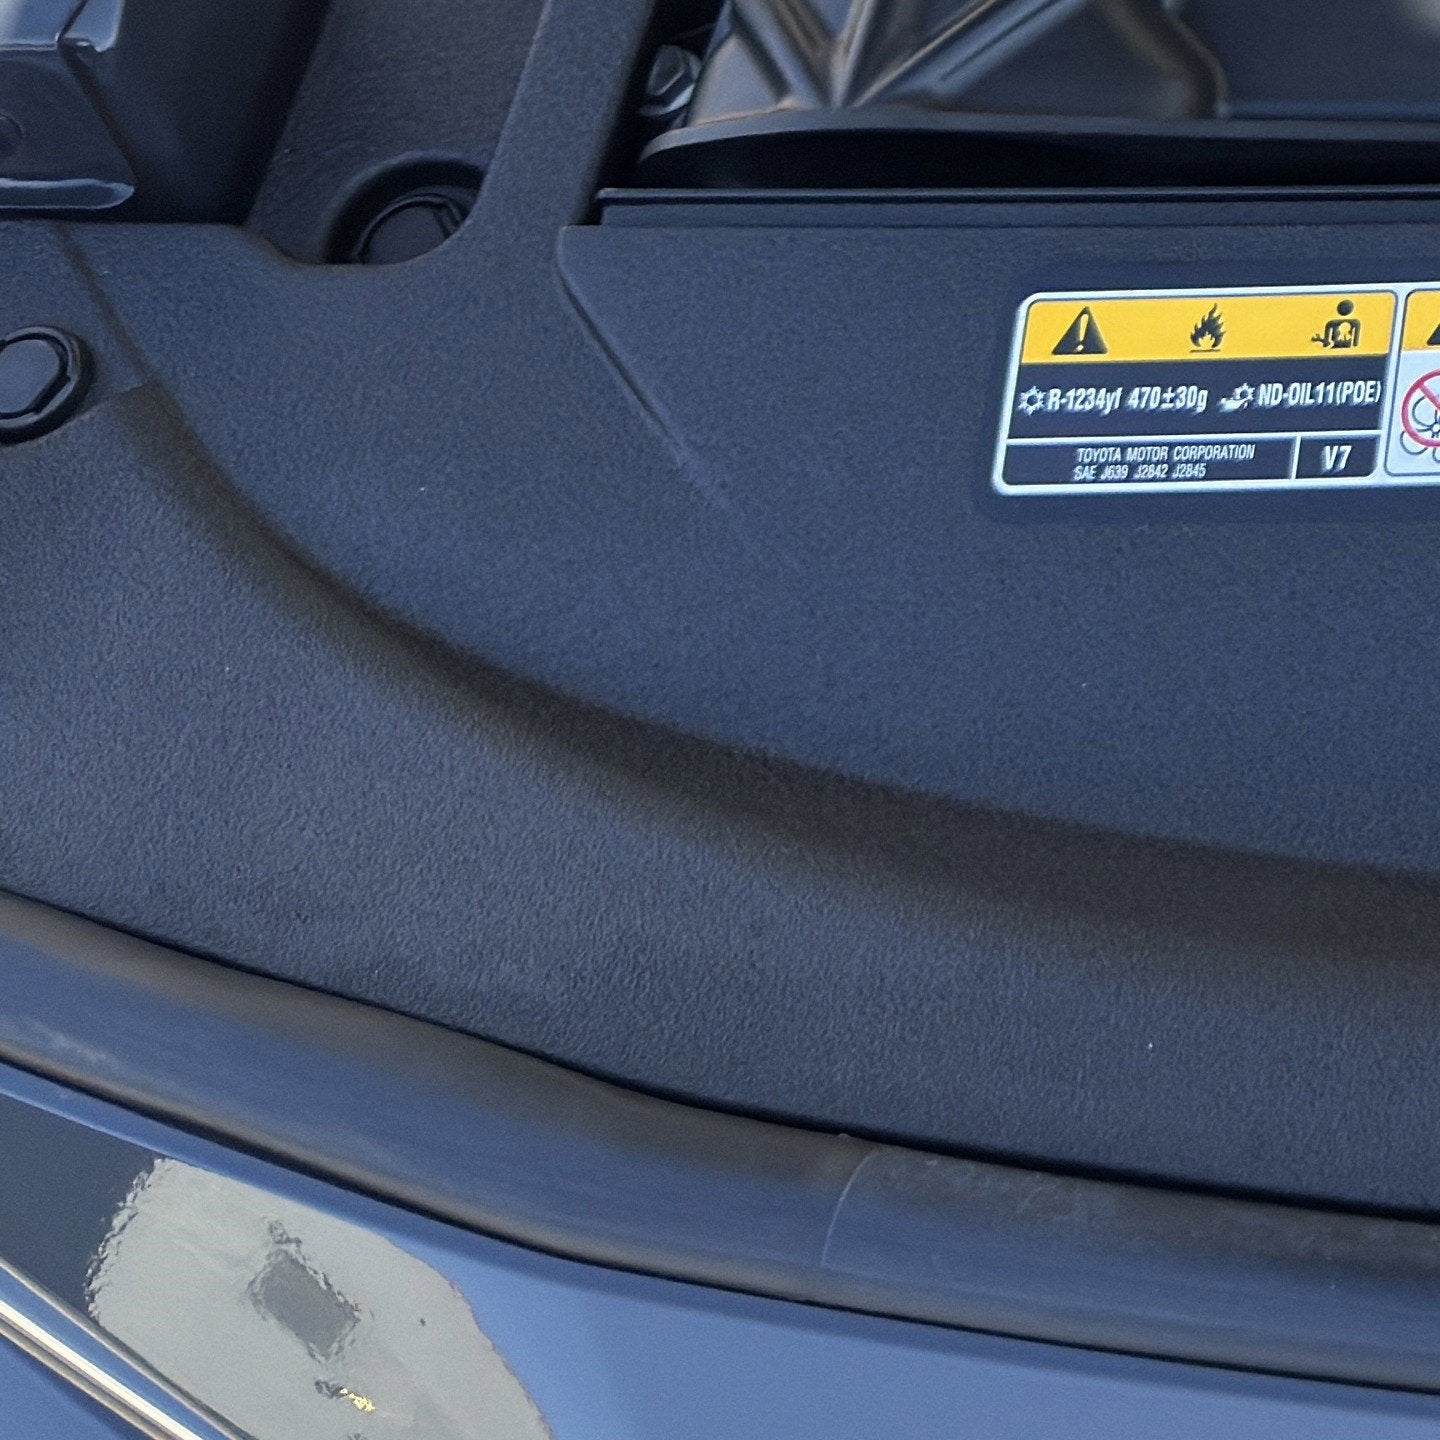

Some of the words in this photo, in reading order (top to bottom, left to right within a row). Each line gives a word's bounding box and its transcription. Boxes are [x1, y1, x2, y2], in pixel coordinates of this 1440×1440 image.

[1049, 386, 1121, 416] R-1234yf
[1128, 383, 1209, 415] 470±30g
[1258, 378, 1382, 409] ND-OIL11(POE)
[1077, 446, 1122, 464] TOYOTA
[1126, 445, 1168, 462] MOTOR
[1173, 443, 1256, 462] CORPORATION
[1322, 444, 1353, 471] V7
[1073, 464, 1097, 481] SAE
[1101, 464, 1129, 481] J639
[1133, 462, 1168, 480] J2842
[1172, 461, 1207, 479] J2845
